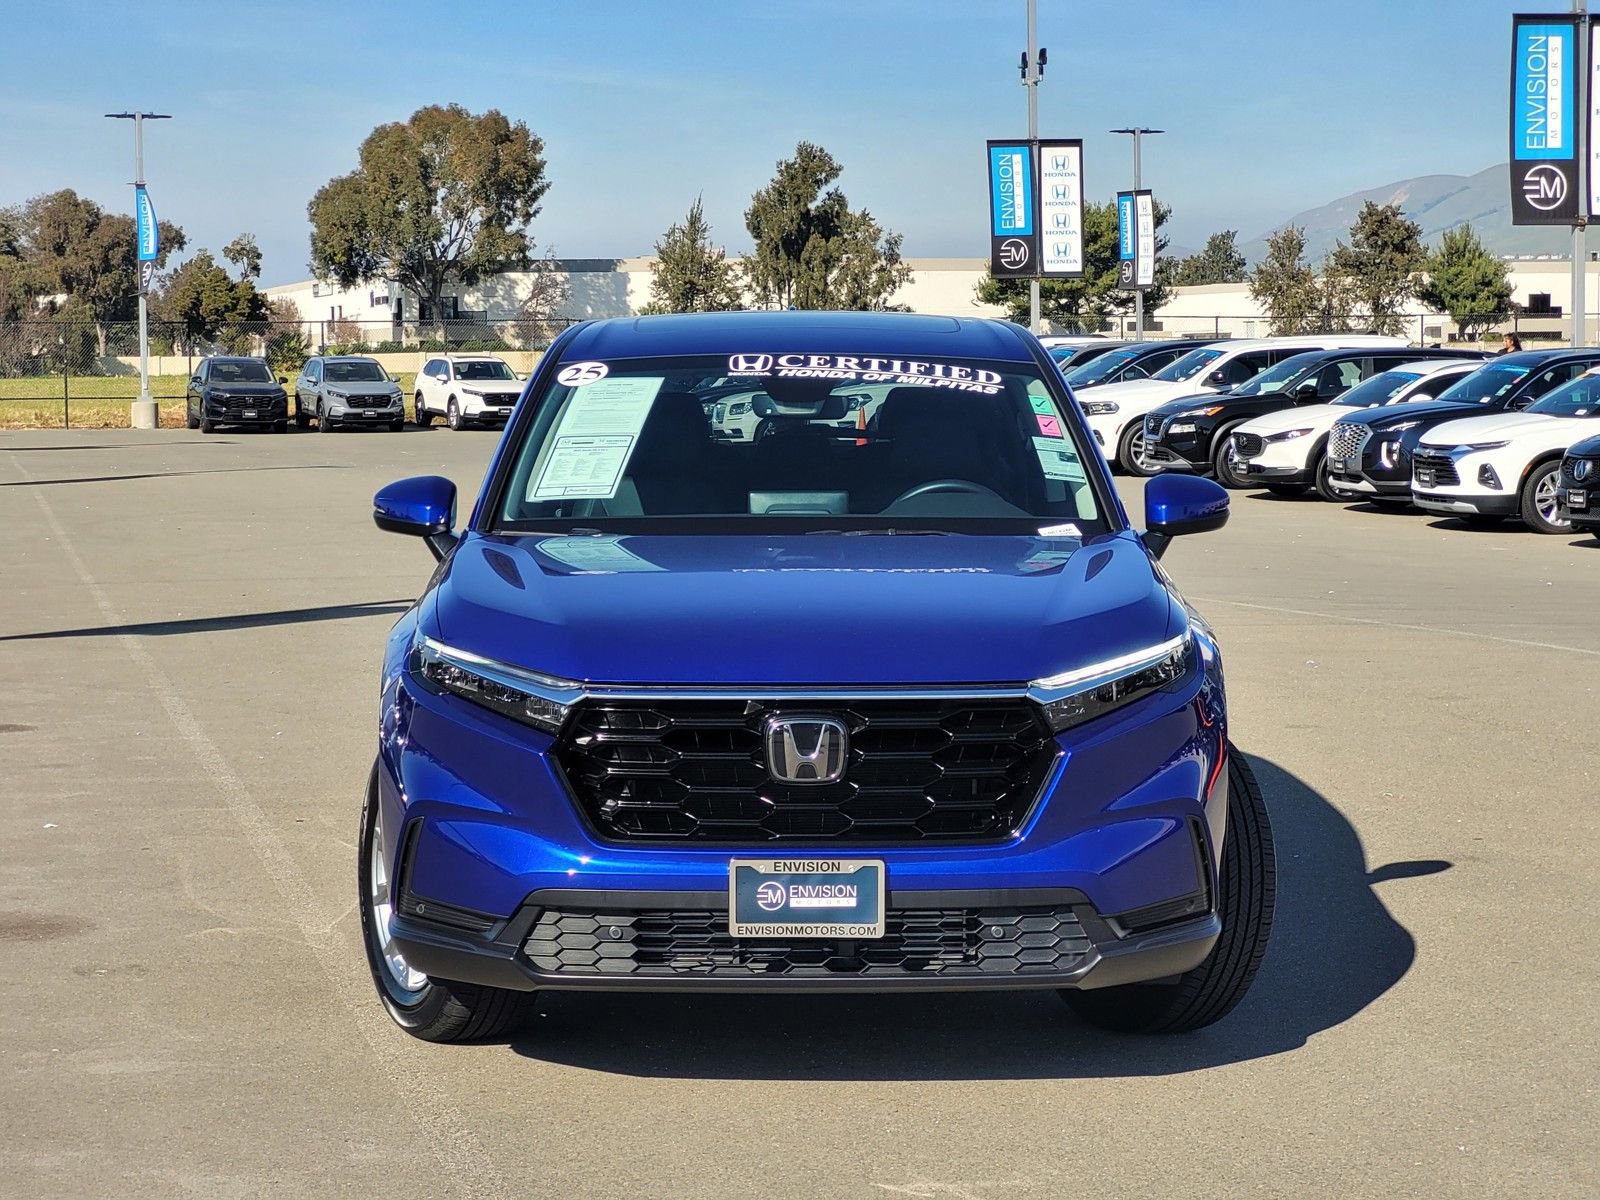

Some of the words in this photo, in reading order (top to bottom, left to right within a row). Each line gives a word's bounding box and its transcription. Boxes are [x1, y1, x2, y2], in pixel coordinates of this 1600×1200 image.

[1526, 35, 1547, 149] ENVISION
[1550, 46, 1559, 139] MOTORS
[998, 154, 1014, 228] ENVISION
[564, 365, 604, 381] 25
[778, 354, 1002, 384] CERTIFIED
[778, 369, 856, 379] HONDA
[862, 373, 894, 382] OF
[896, 376, 999, 394] MILPITAS
[773, 861, 841, 872] ENVISION
[789, 885, 857, 898] ENVISION
[737, 926, 877, 936] ENVISIONMOTORS.COM
